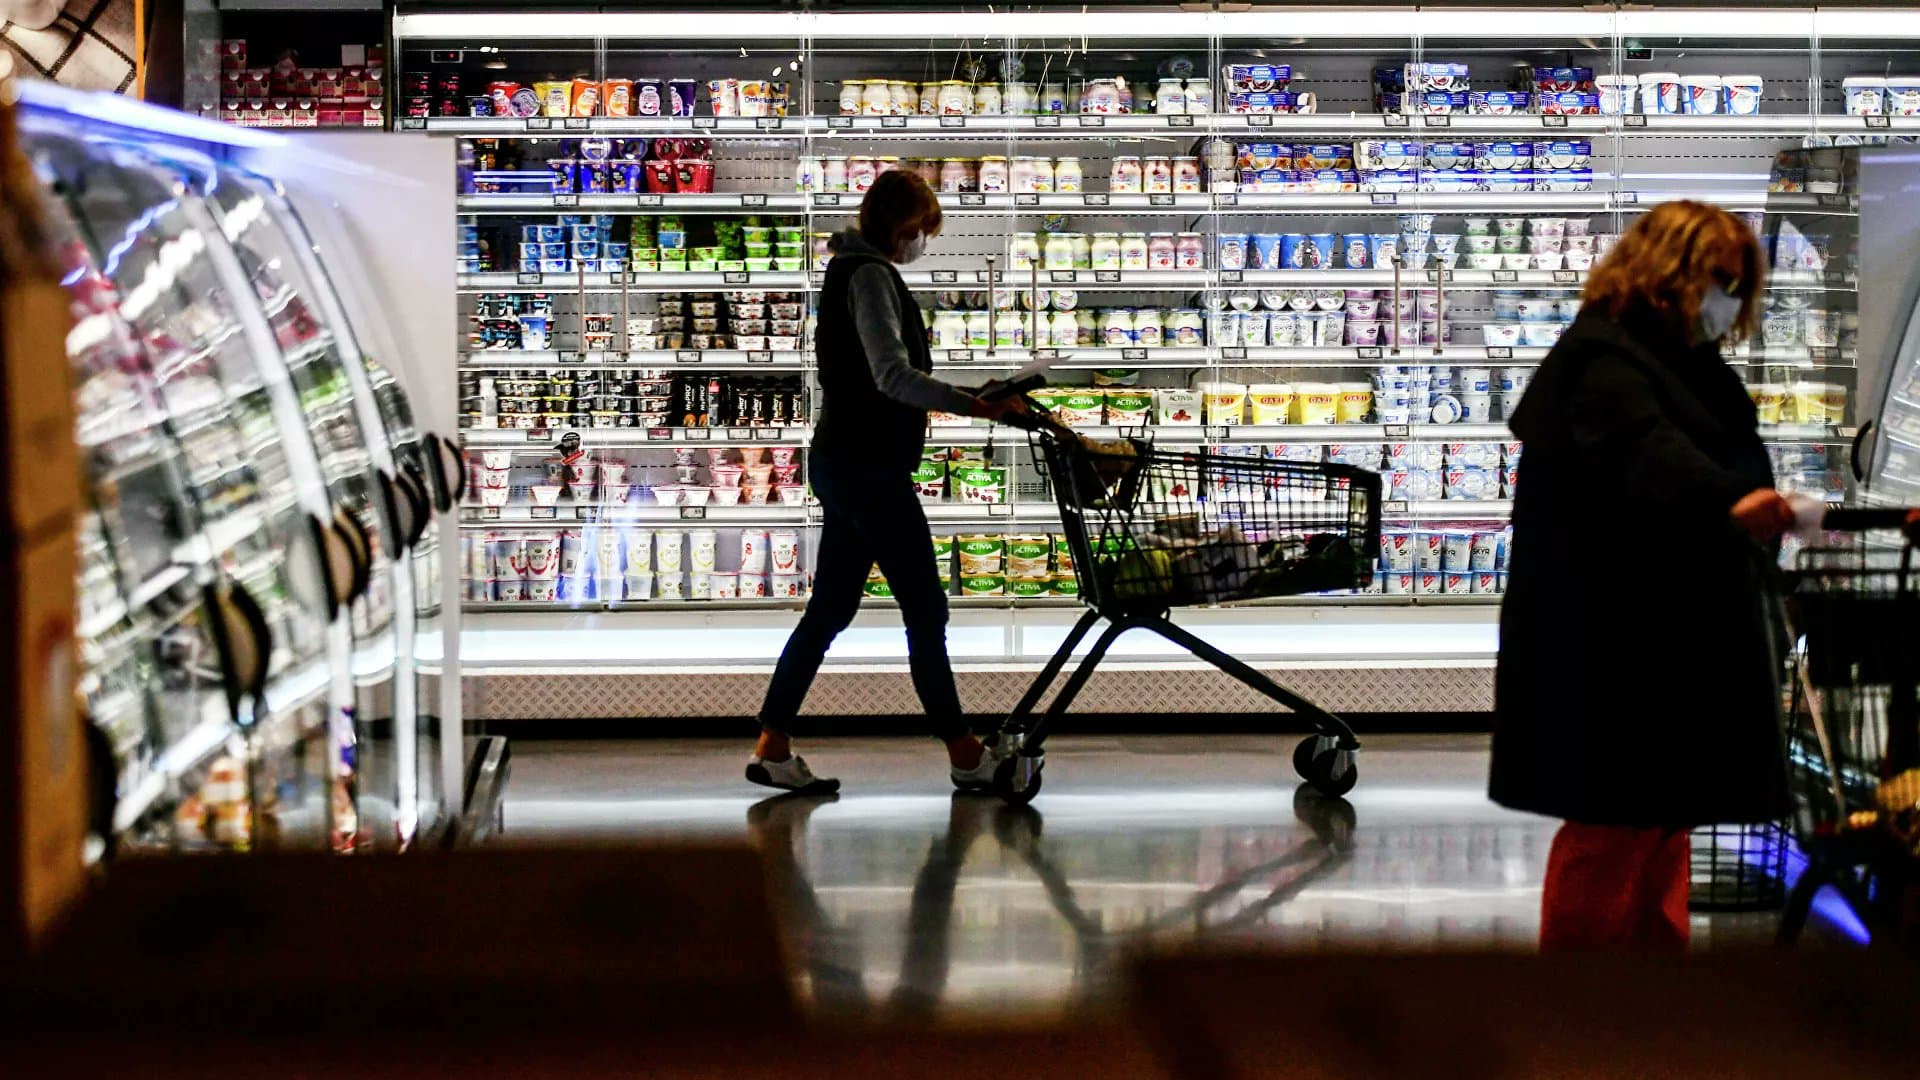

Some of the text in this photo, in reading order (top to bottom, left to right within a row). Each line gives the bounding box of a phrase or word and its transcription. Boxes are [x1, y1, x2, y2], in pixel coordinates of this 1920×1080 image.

[1067, 397, 1095, 406] ACTIVIA
[1115, 399, 1143, 407] ACTIVIA
[966, 474, 993, 482] ACTIVIA
[966, 542, 993, 551] ACTIVIA
[1472, 547, 1490, 555] SKYR
[968, 580, 996, 588] ACTIVIA
